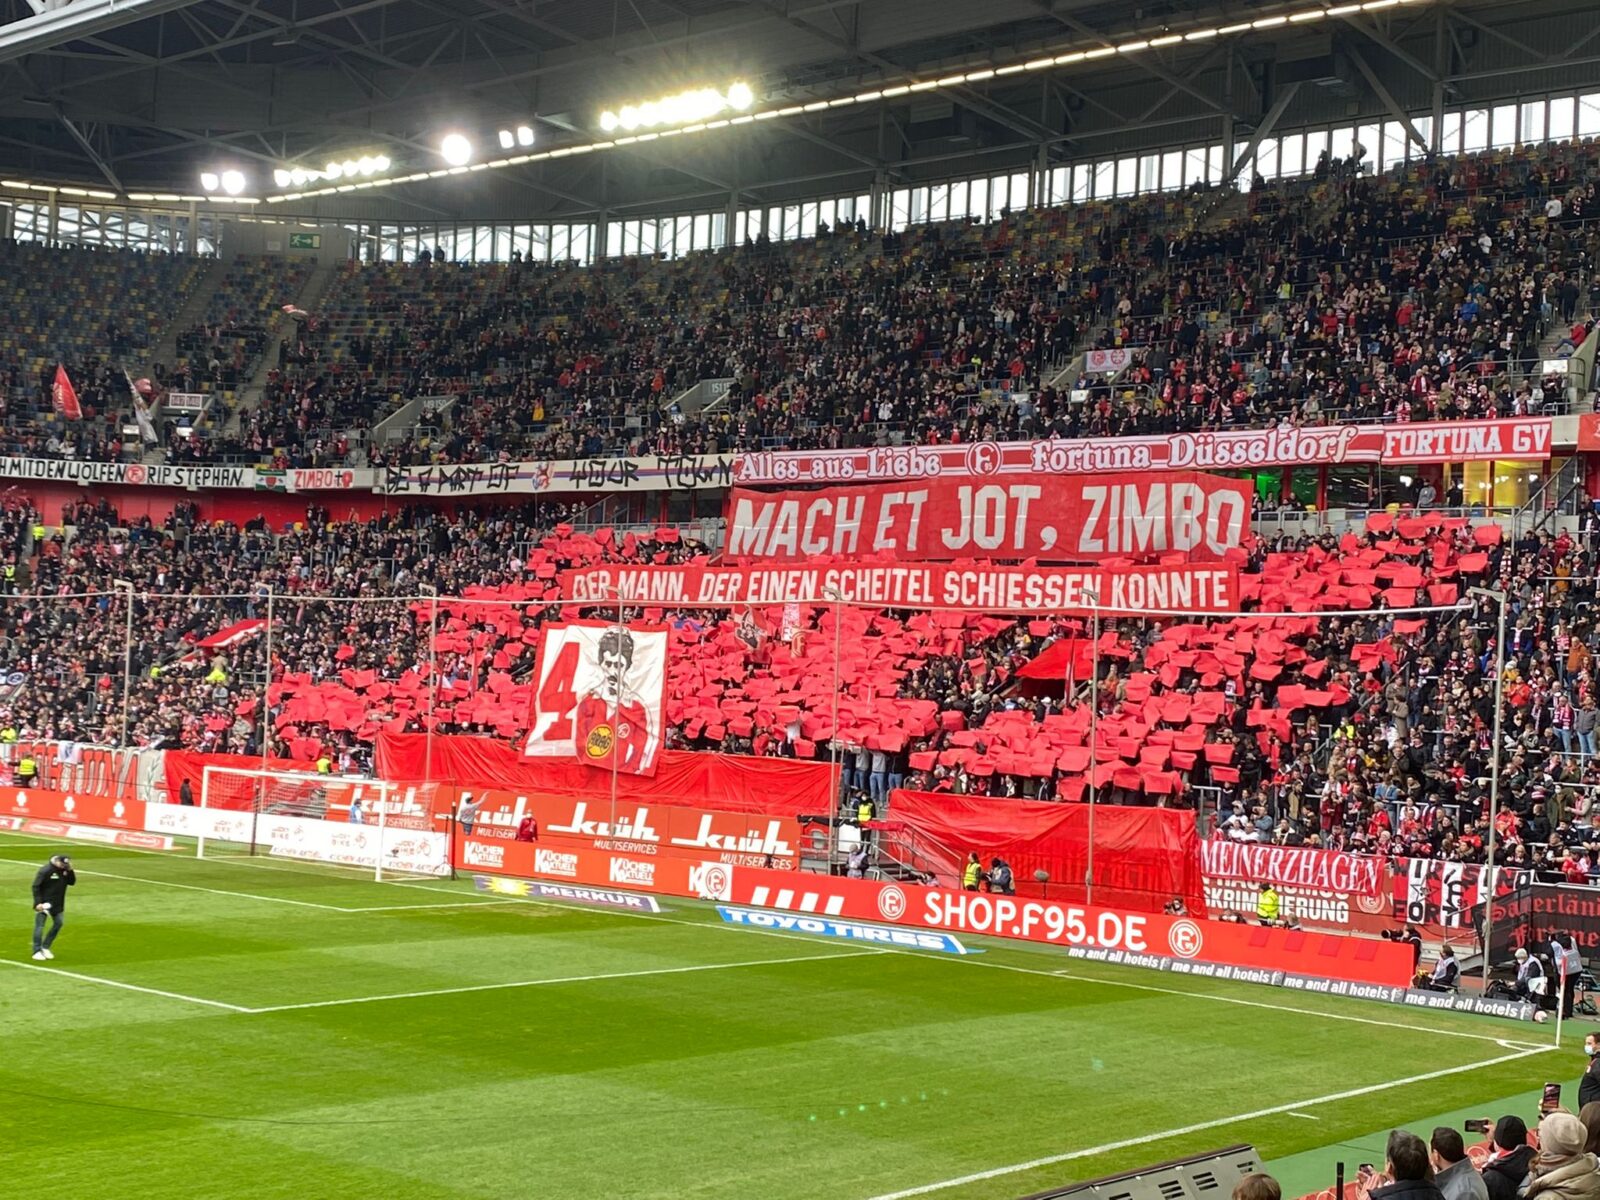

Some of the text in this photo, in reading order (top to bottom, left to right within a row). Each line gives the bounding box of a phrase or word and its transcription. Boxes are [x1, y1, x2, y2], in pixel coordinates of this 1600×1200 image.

[738, 453, 799, 482] Alles
[810, 457, 855, 479] aus
[867, 447, 941, 478] Liebe
[1032, 439, 1151, 472] Fortuna
[1167, 427, 1358, 467] Düsseldorf
[1386, 424, 1550, 457] FORTUNA GV
[147, 466, 171, 484] RIP
[294, 470, 332, 488] ZIMBO
[386, 465, 411, 493] BE
[729, 482, 1246, 557] MACH ET JOT, ZIMBO
[572, 569, 611, 600] DER
[700, 571, 741, 601] DER
[747, 570, 818, 601] EINEN
[824, 568, 934, 604] SCHEITEL
[943, 571, 1102, 609] SCHIESSEN
[1112, 570, 1229, 609] KONNTE
[539, 642, 580, 741] 4
[720, 852, 792, 870] MULTISERCES
[1200, 839, 1383, 895] MEINERZHAGEN
[540, 885, 642, 907] MERKUR
[1203, 888, 1349, 924] KRIMIERUNG
[1482, 893, 1600, 921] Saerlän
[725, 909, 945, 950] TOYO TIRES
[923, 891, 1148, 951] SHOP.F95.DE
[1068, 947, 1158, 968] me and all hotels
[1172, 962, 1269, 984] me and all hotels
[1284, 977, 1389, 1000] me and all hotels
[1406, 994, 1518, 1018] me and all hotels
